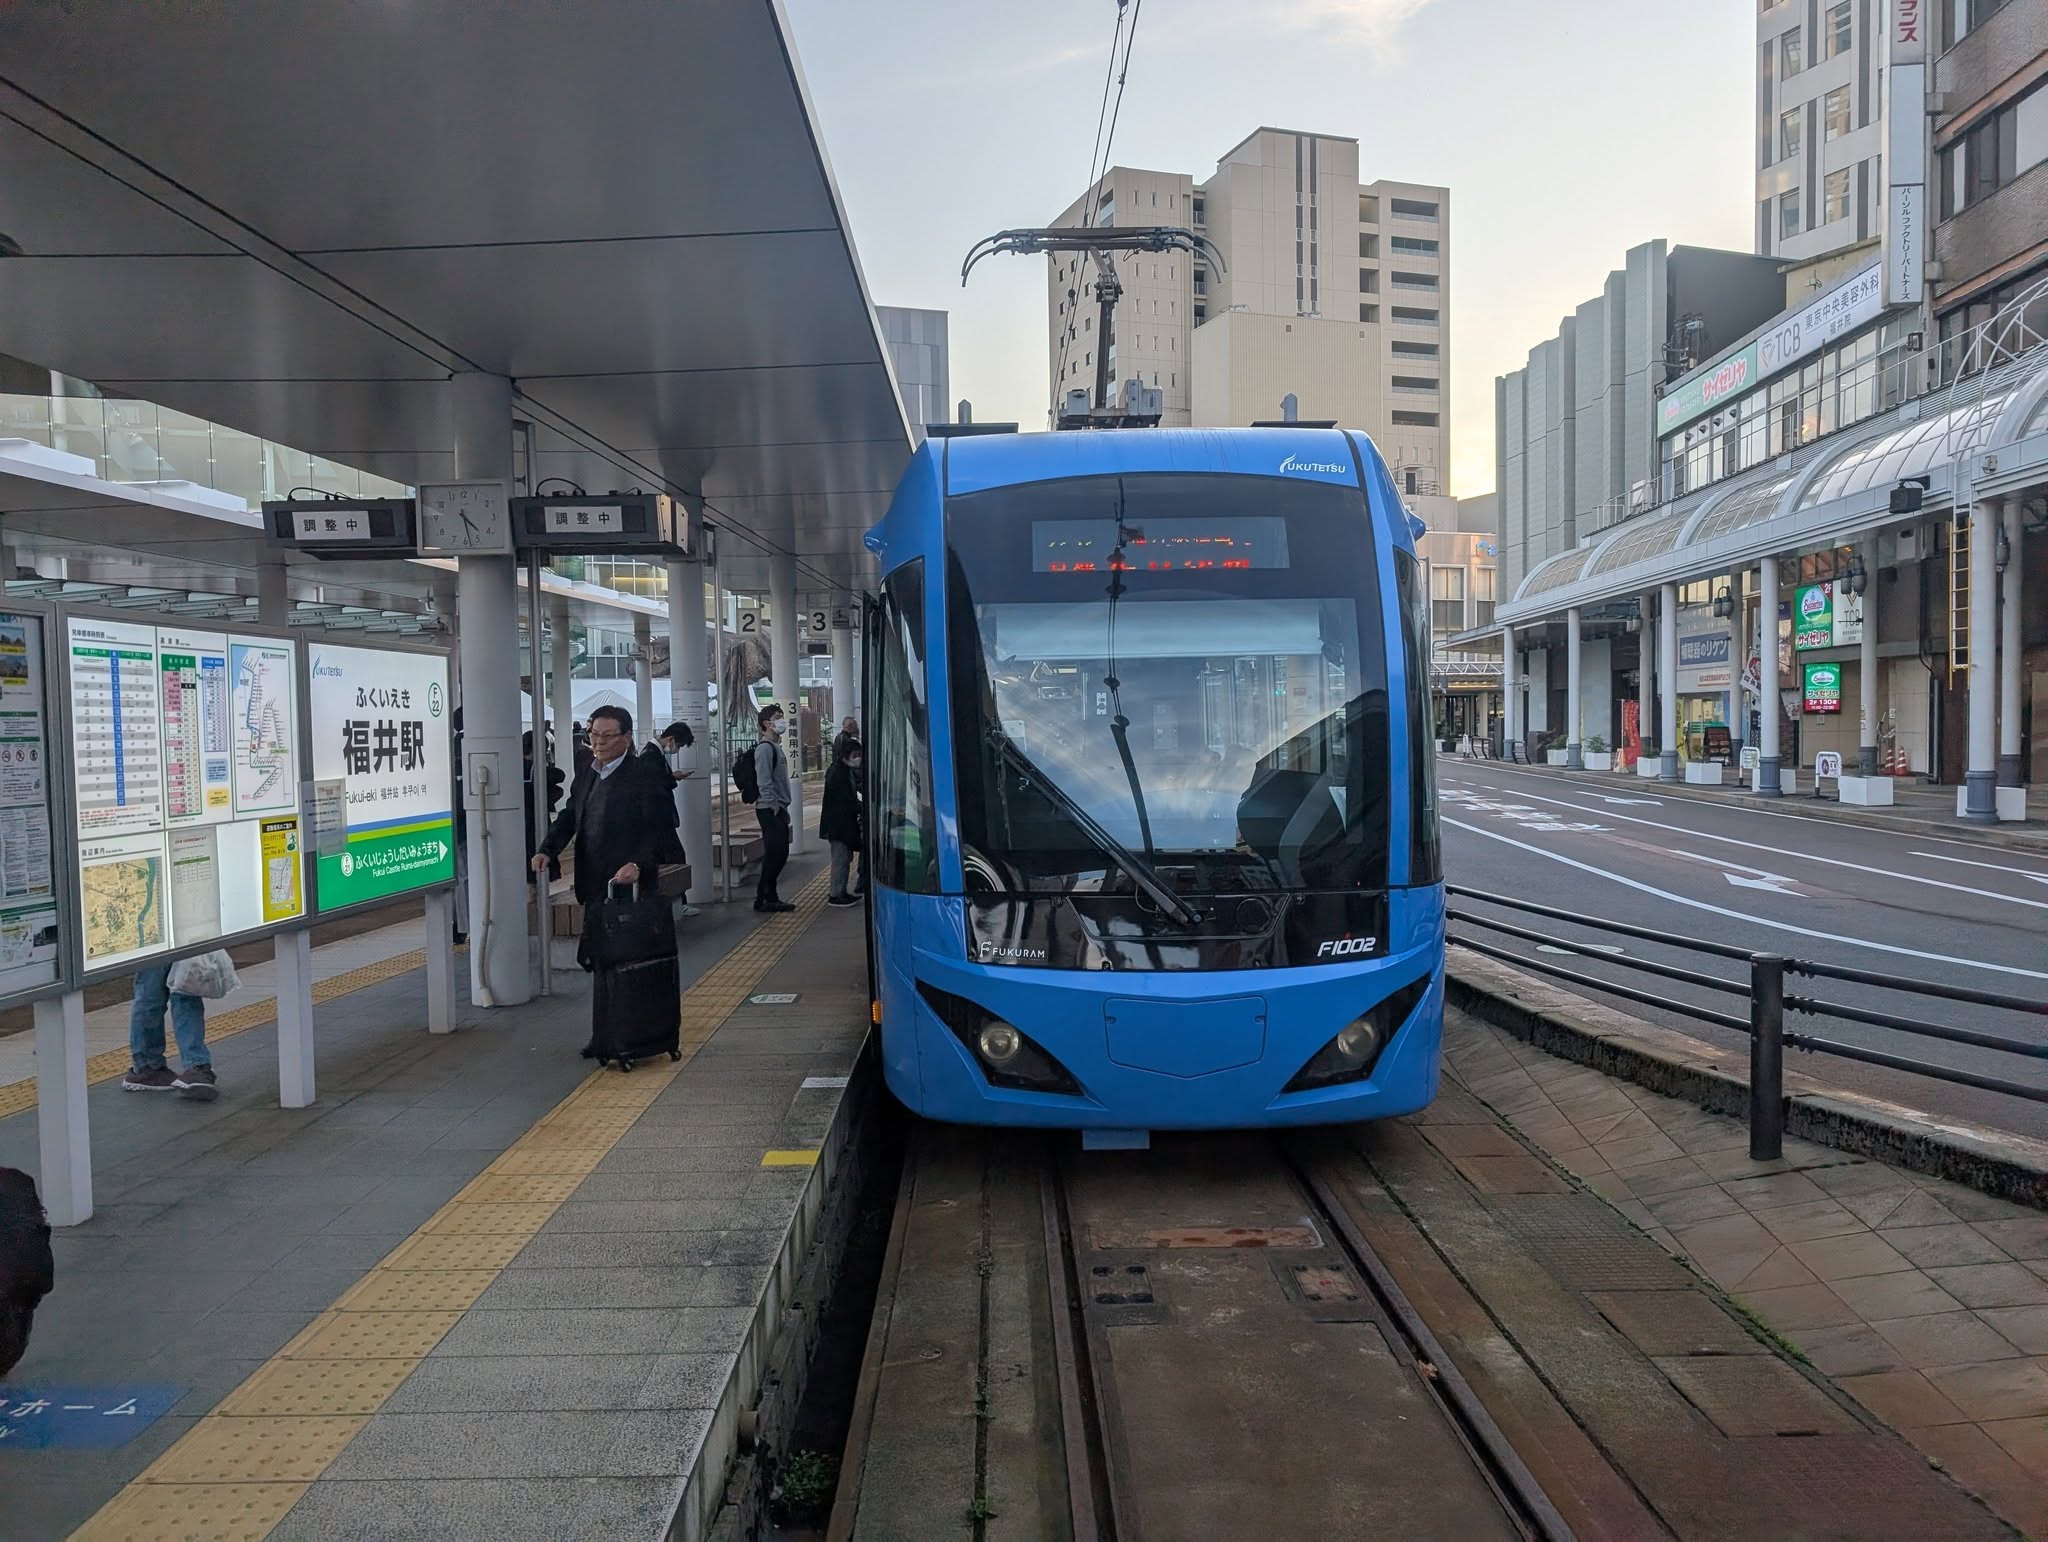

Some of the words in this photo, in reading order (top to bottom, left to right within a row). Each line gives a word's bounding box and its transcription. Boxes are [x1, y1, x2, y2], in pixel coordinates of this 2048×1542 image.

[1901, 187, 1911, 300] パーソルファクトリーパートナーズ
[1805, 272, 1879, 330] 東京中央美容外科
[1775, 322, 1801, 362] TCB
[1703, 357, 1747, 405] サイゼリヤ
[303, 518, 358, 533] 調整中
[555, 510, 611, 525] 調整中
[1824, 583, 1832, 594] 2F
[742, 613, 756, 633] 2
[812, 611, 826, 632] 3
[1797, 629, 1829, 648] サイゼリヤ
[356, 687, 411, 709] ふくいえき
[433, 687, 438, 699] F
[432, 701, 440, 712] 22
[343, 719, 425, 775] 福井駅
[356, 842, 438, 869] ふくいじょうしだいみょうまち
[372, 867, 385, 878] Fukui
[992, 947, 1045, 958] FUKURAM
[1317, 937, 1376, 957] F1002
